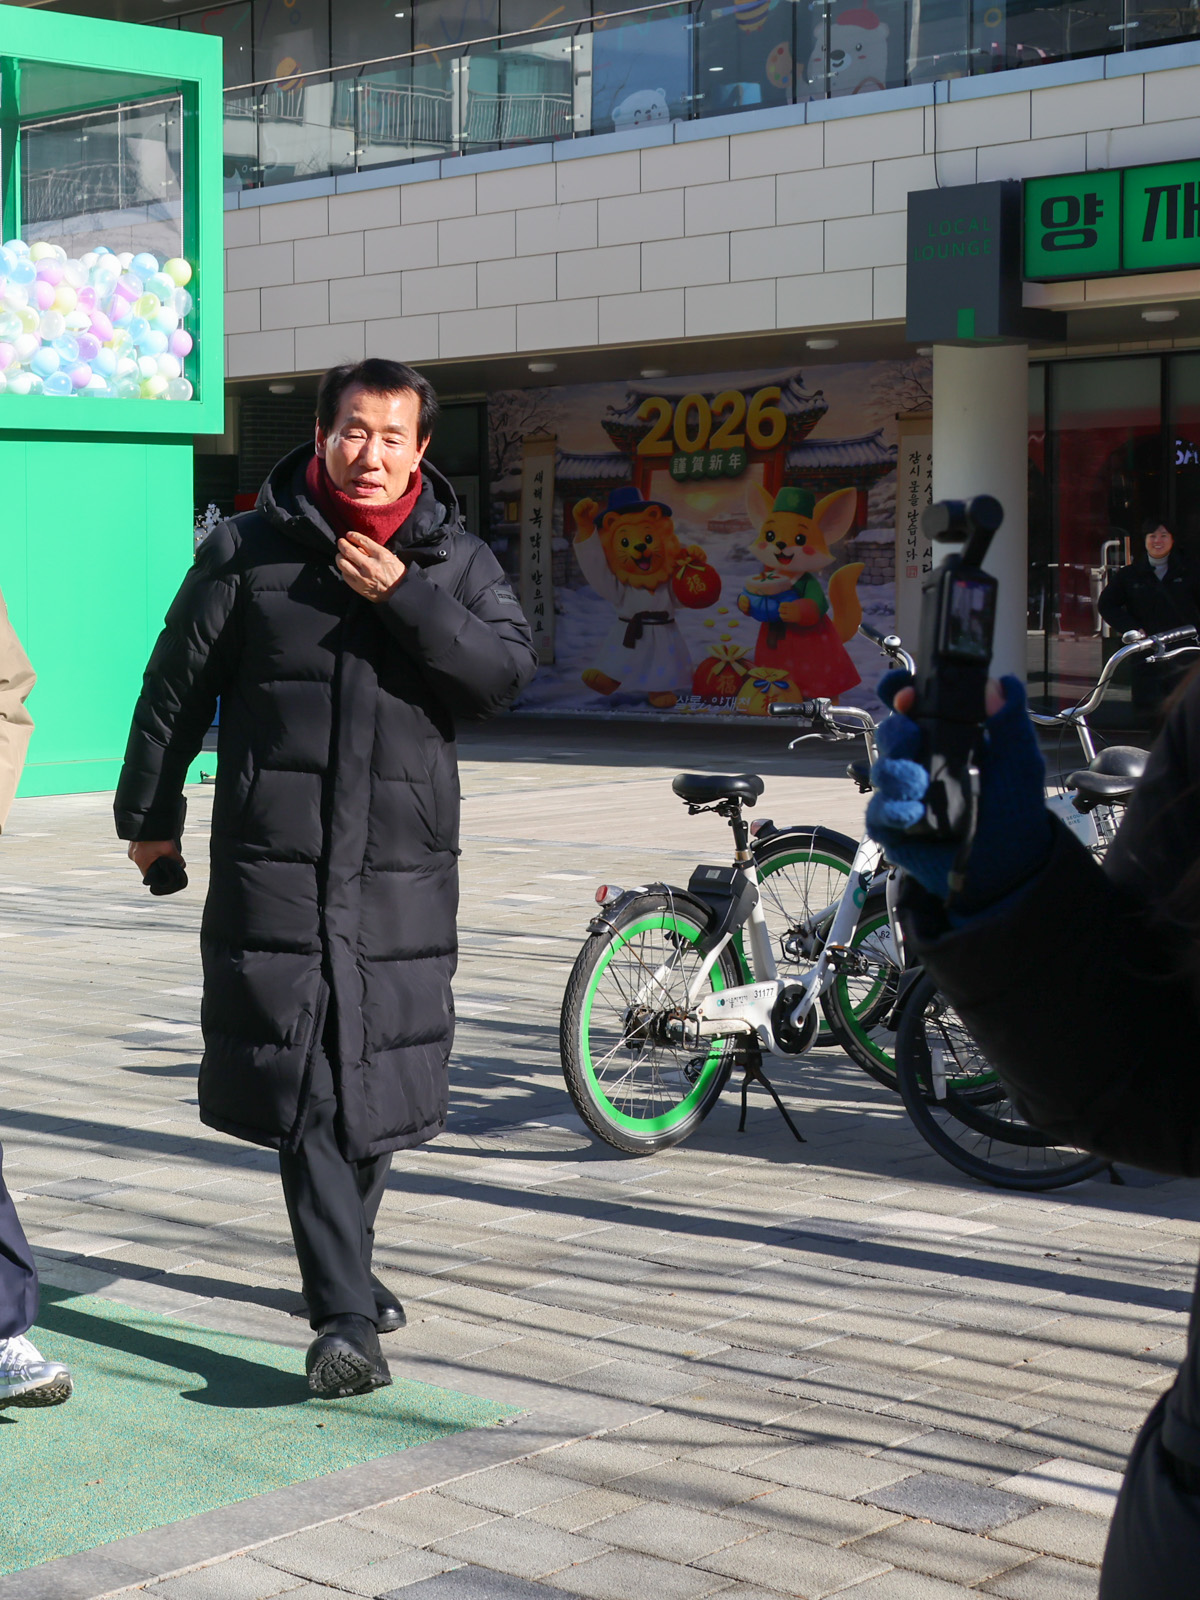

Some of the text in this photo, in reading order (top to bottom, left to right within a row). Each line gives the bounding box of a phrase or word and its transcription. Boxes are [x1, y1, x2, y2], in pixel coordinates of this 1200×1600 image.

[928, 216, 992, 238] LOCAL
[913, 238, 992, 262] LOUNGE
[636, 386, 787, 456] 2026
[672, 452, 742, 474] 謹賀新年
[908, 450, 921, 478] 잠시
[529, 507, 543, 529] 복
[530, 532, 542, 564] 많이
[686, 574, 707, 596] 福
[531, 570, 545, 634] 받으세요
[754, 988, 774, 999] 31177
